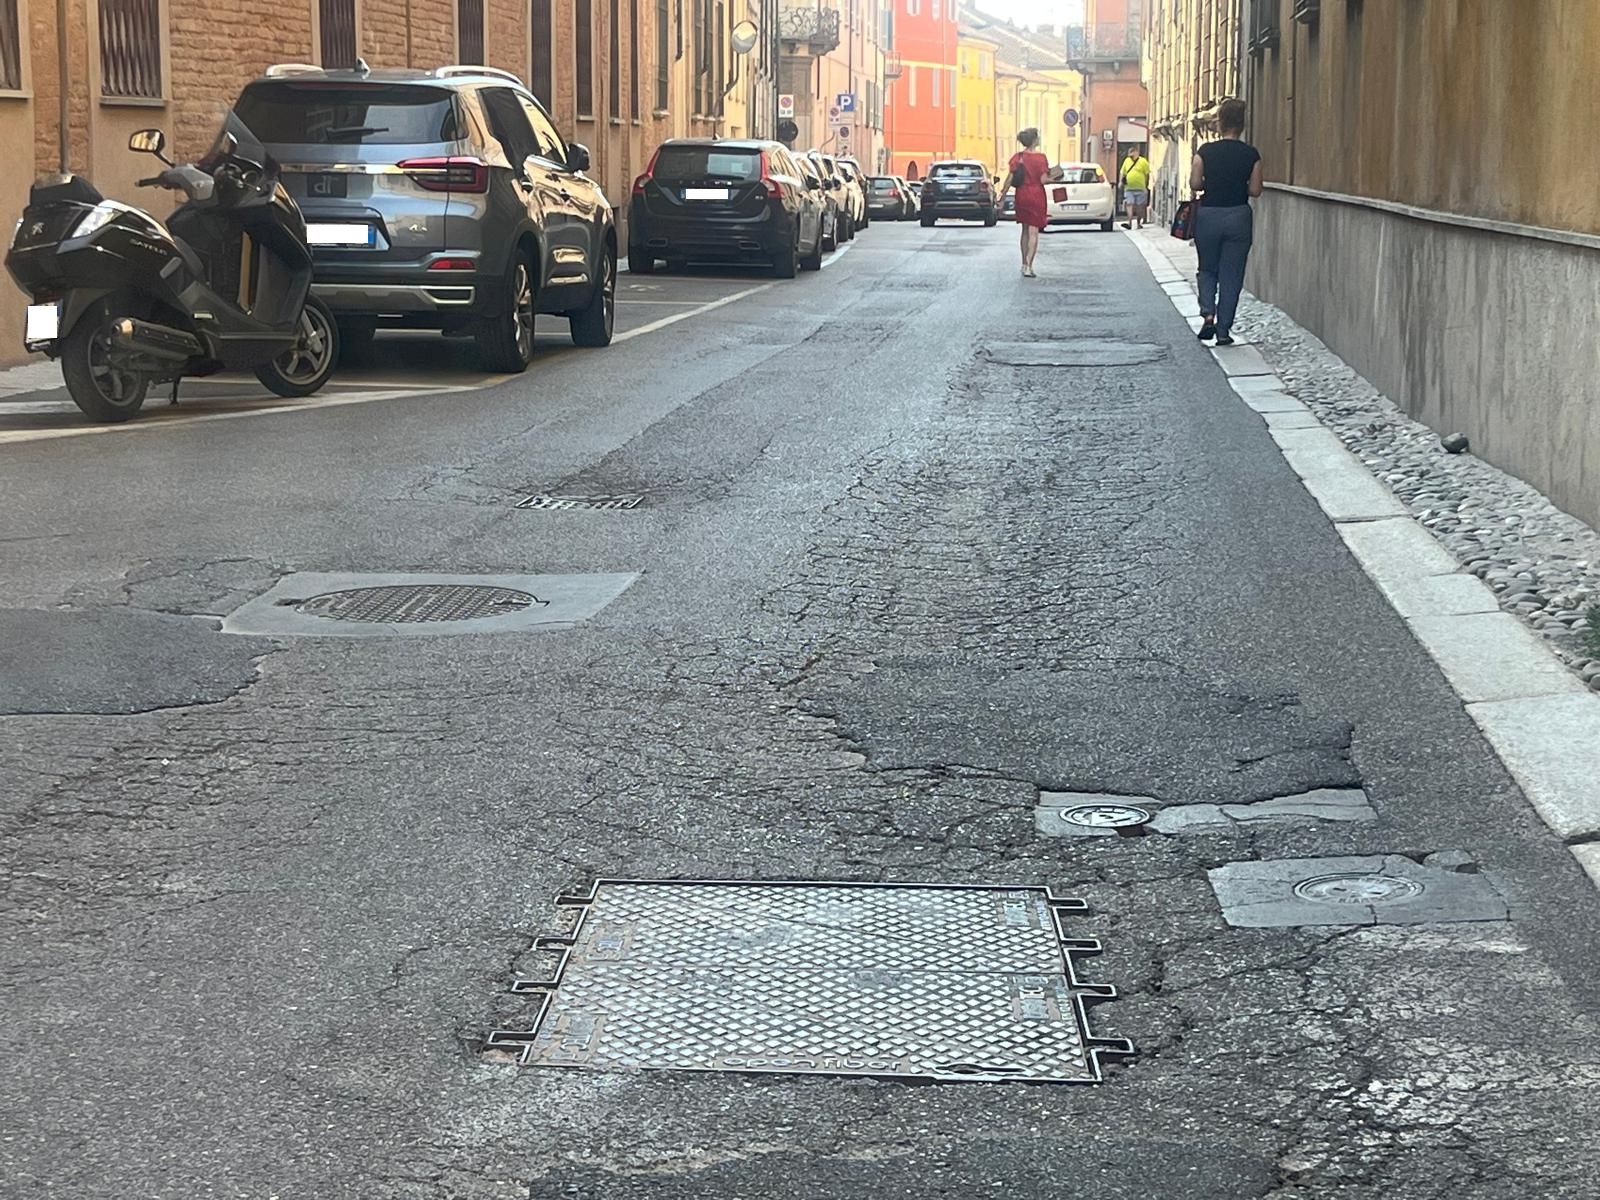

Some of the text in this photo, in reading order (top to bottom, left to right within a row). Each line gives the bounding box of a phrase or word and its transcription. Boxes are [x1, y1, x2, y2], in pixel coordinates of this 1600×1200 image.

[840, 95, 851, 110] P
[722, 1056, 902, 1071] open fiber
